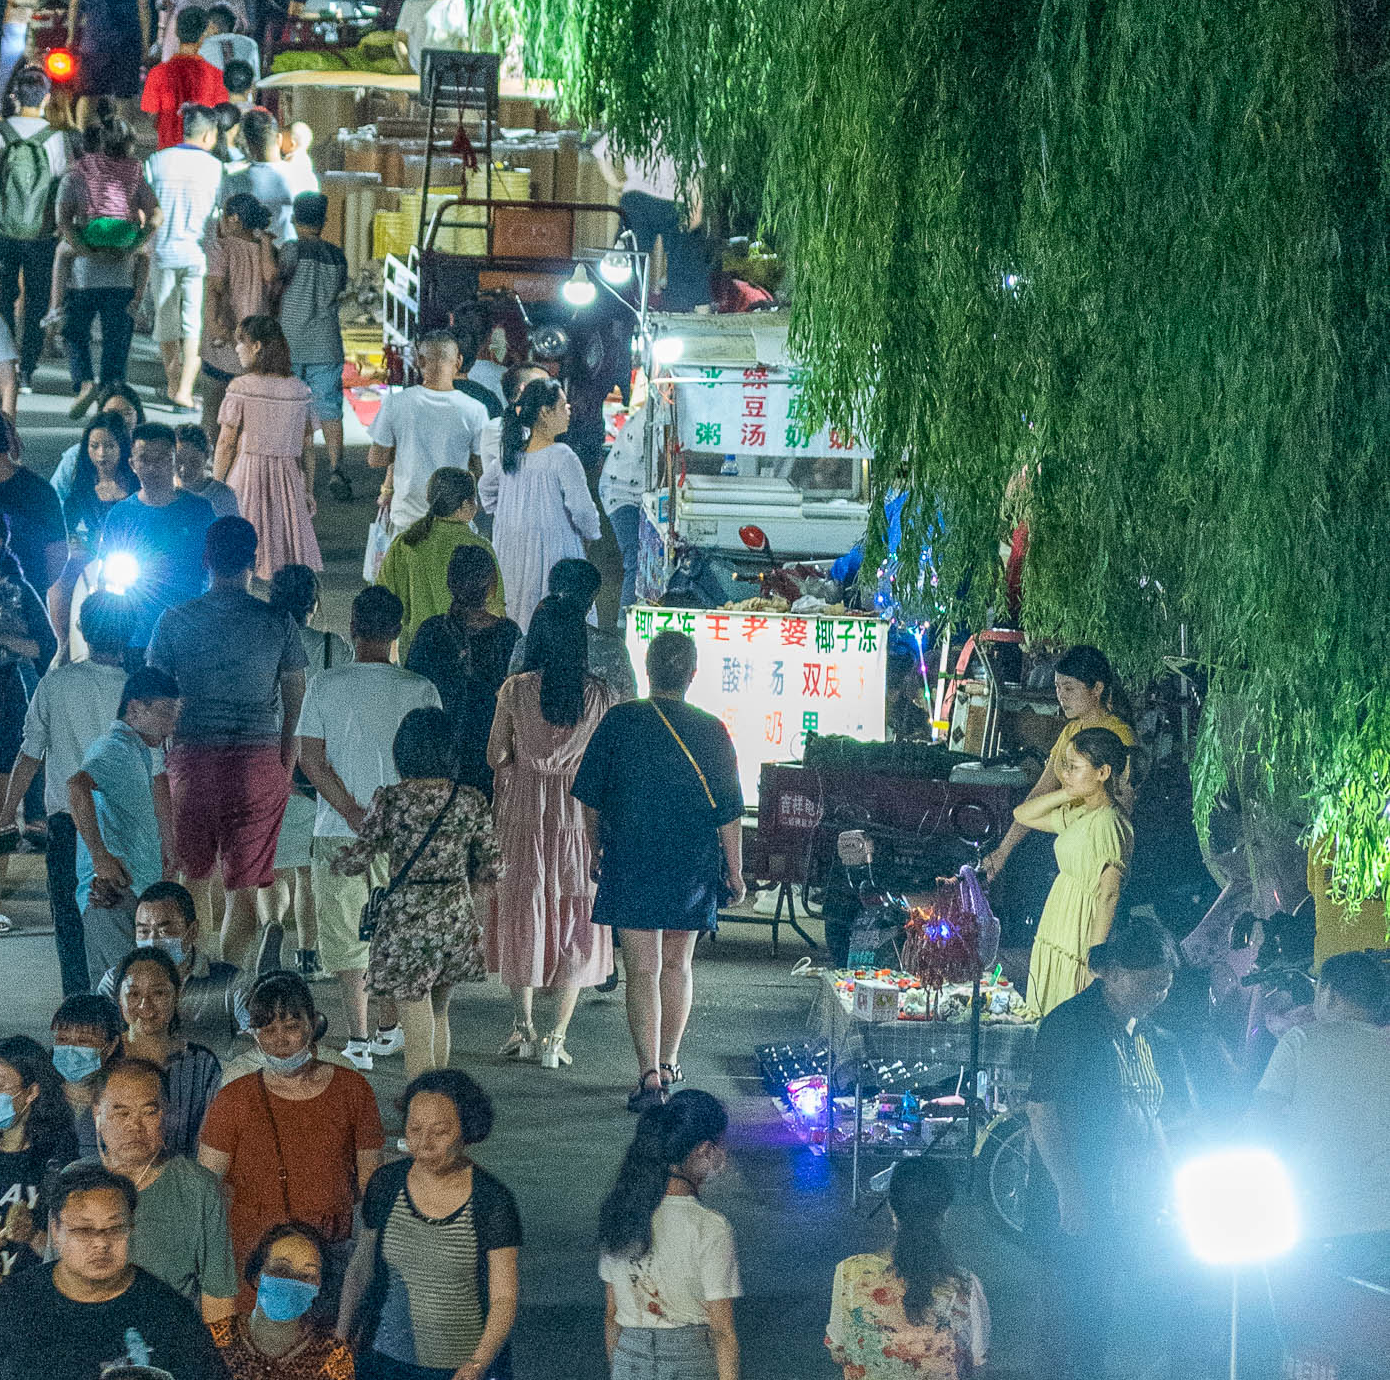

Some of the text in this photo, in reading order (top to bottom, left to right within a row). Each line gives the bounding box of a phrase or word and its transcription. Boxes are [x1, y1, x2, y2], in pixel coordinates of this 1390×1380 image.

[741, 367, 768, 447] 绿豆汤
[814, 619, 877, 654] 椰子冻
